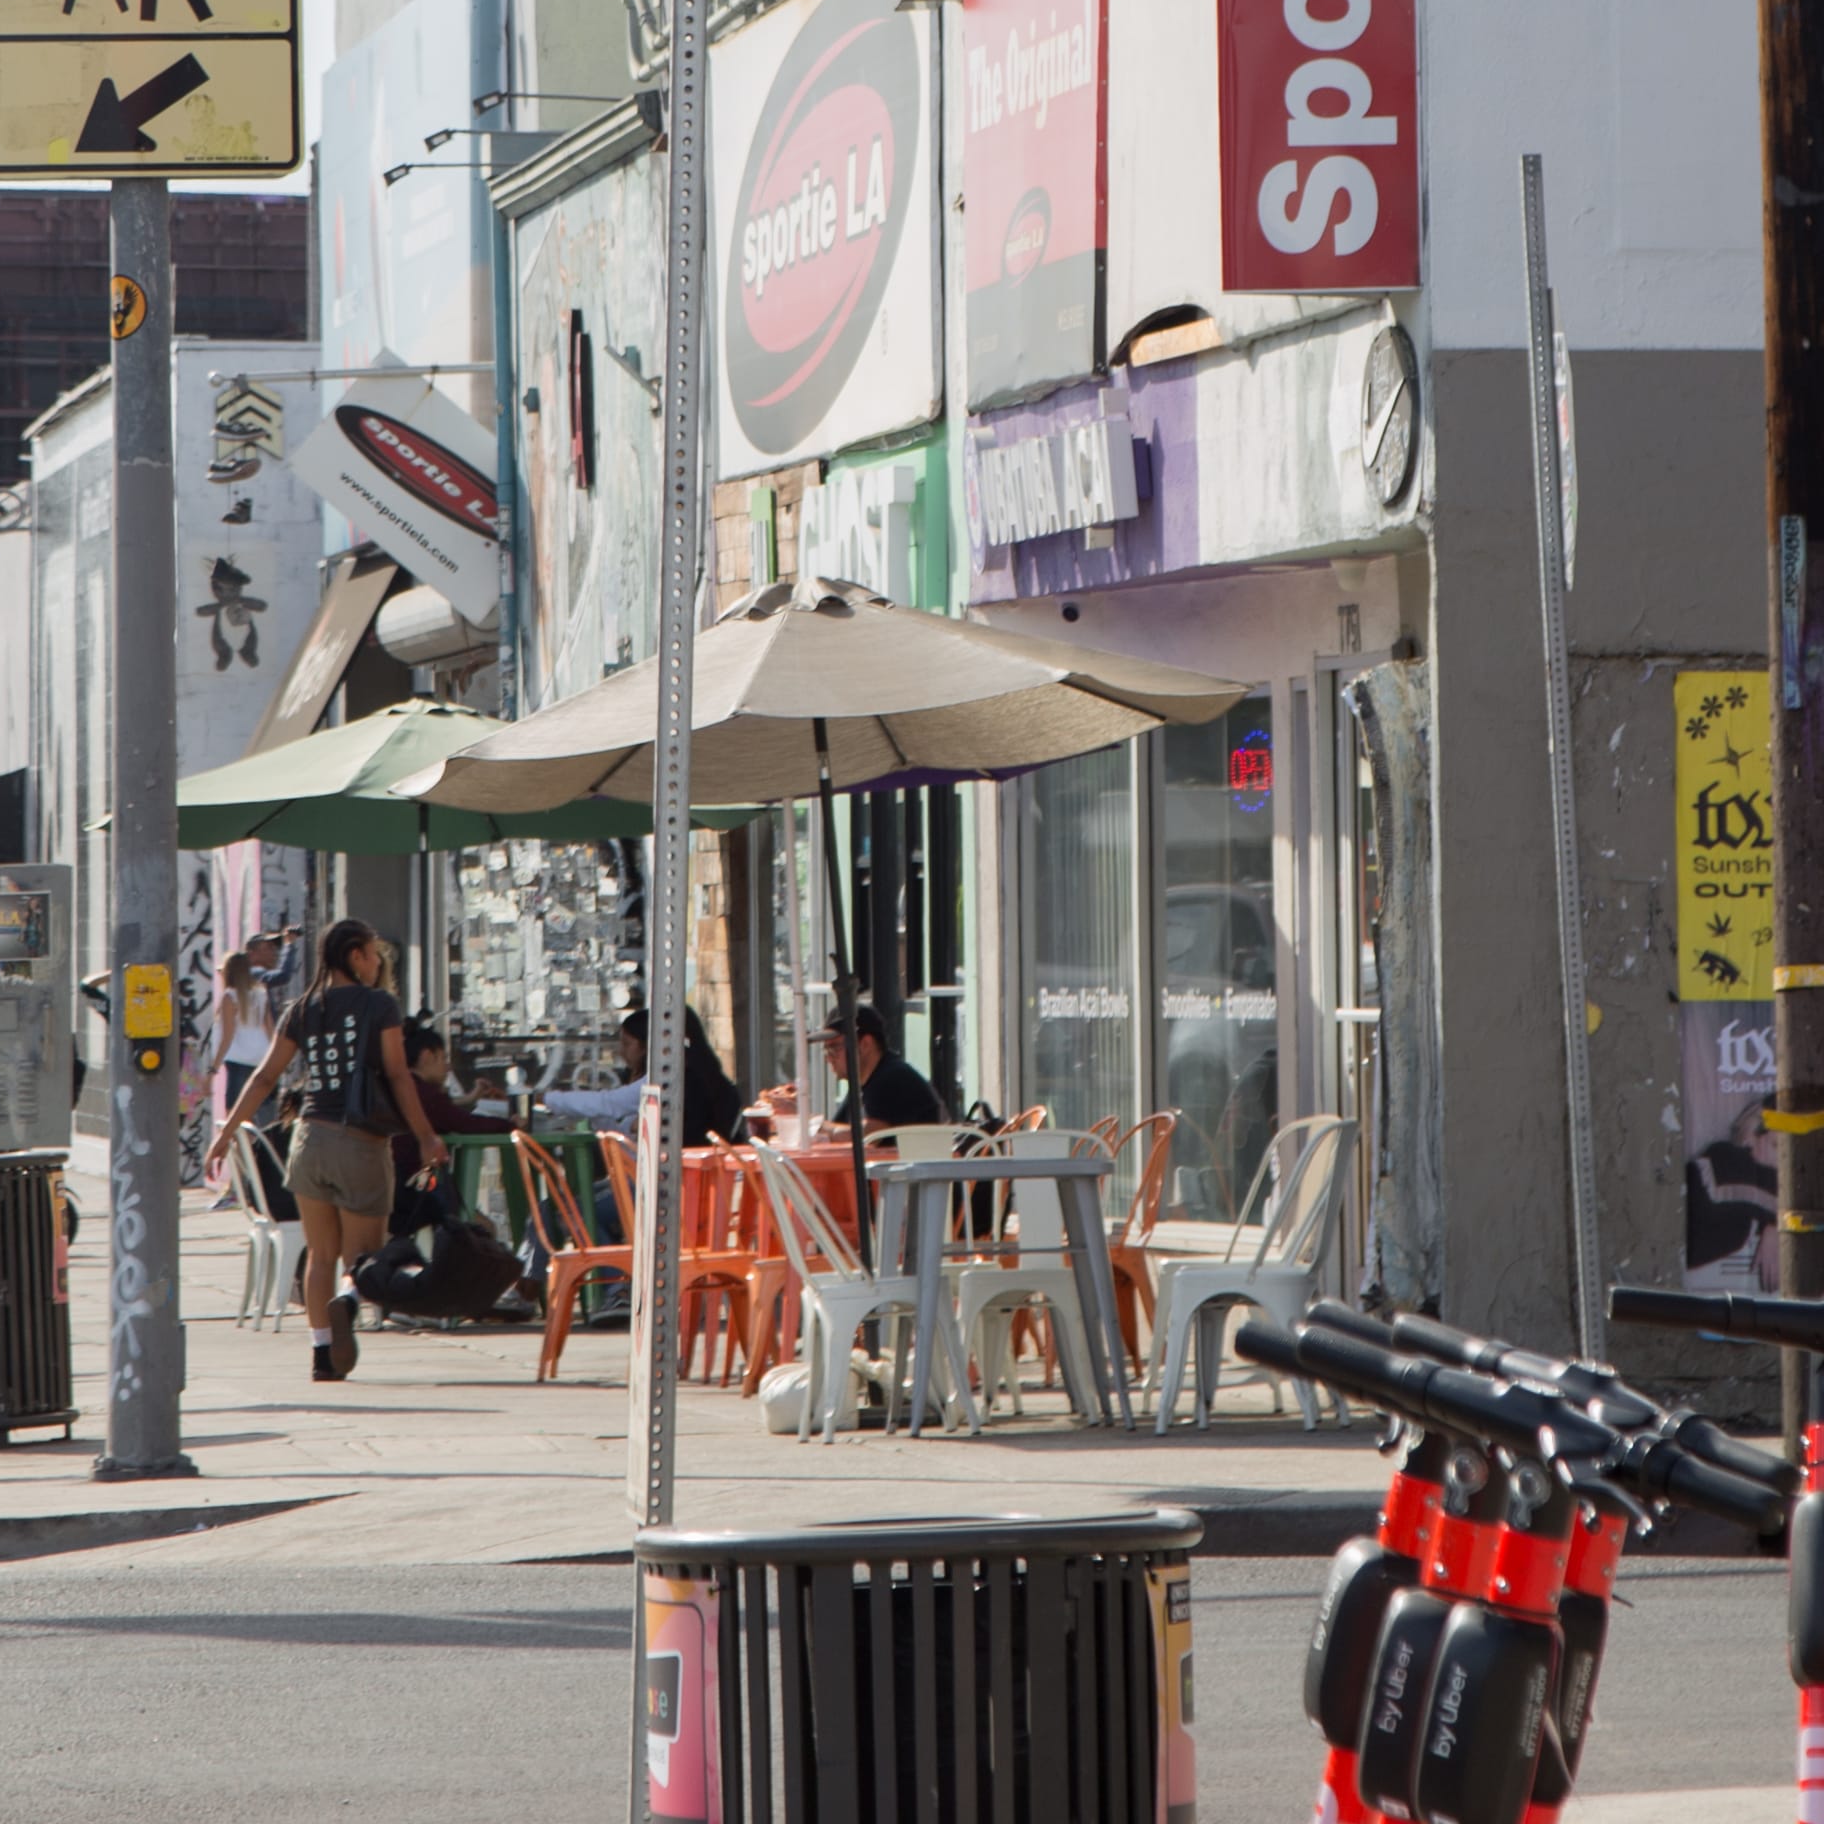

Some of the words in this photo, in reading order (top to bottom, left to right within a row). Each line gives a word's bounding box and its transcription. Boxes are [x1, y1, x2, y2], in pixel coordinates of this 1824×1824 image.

[968, 45, 1003, 134] The
[743, 162, 838, 297] sportie
[846, 134, 888, 241] LA
[339, 471, 460, 574] www.sportiela.com
[1693, 856, 1771, 874] Sunsh
[1694, 883, 1773, 898] OUT
[1312, 1619, 1330, 1652] by
[1385, 1639, 1415, 1700] Uber
[1442, 1663, 1468, 1725] Uber
[1377, 1697, 1403, 1735] by
[1433, 1722, 1456, 1759] by
